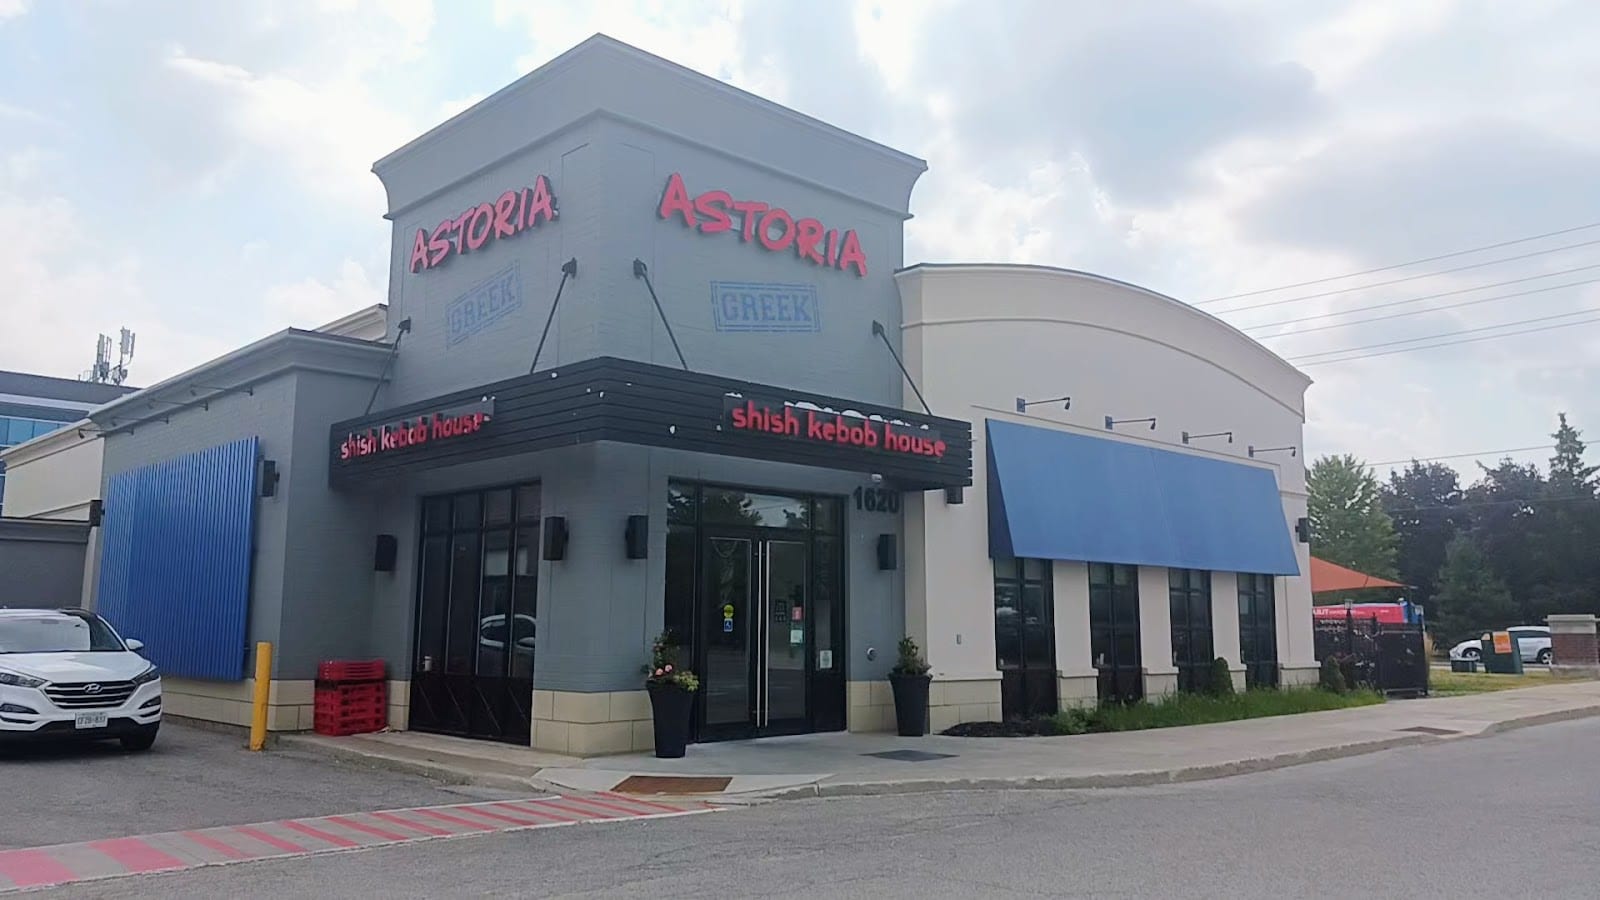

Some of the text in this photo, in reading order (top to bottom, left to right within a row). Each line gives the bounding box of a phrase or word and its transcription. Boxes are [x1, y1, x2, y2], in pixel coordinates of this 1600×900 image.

[410, 174, 557, 273] ASTORIA
[659, 172, 867, 278] ASTORIA
[450, 274, 513, 334] GREEK
[722, 291, 811, 323] GREEK
[341, 411, 483, 459] shish kebob house
[731, 400, 946, 457] shish kebob house
[853, 486, 900, 514] 1620
